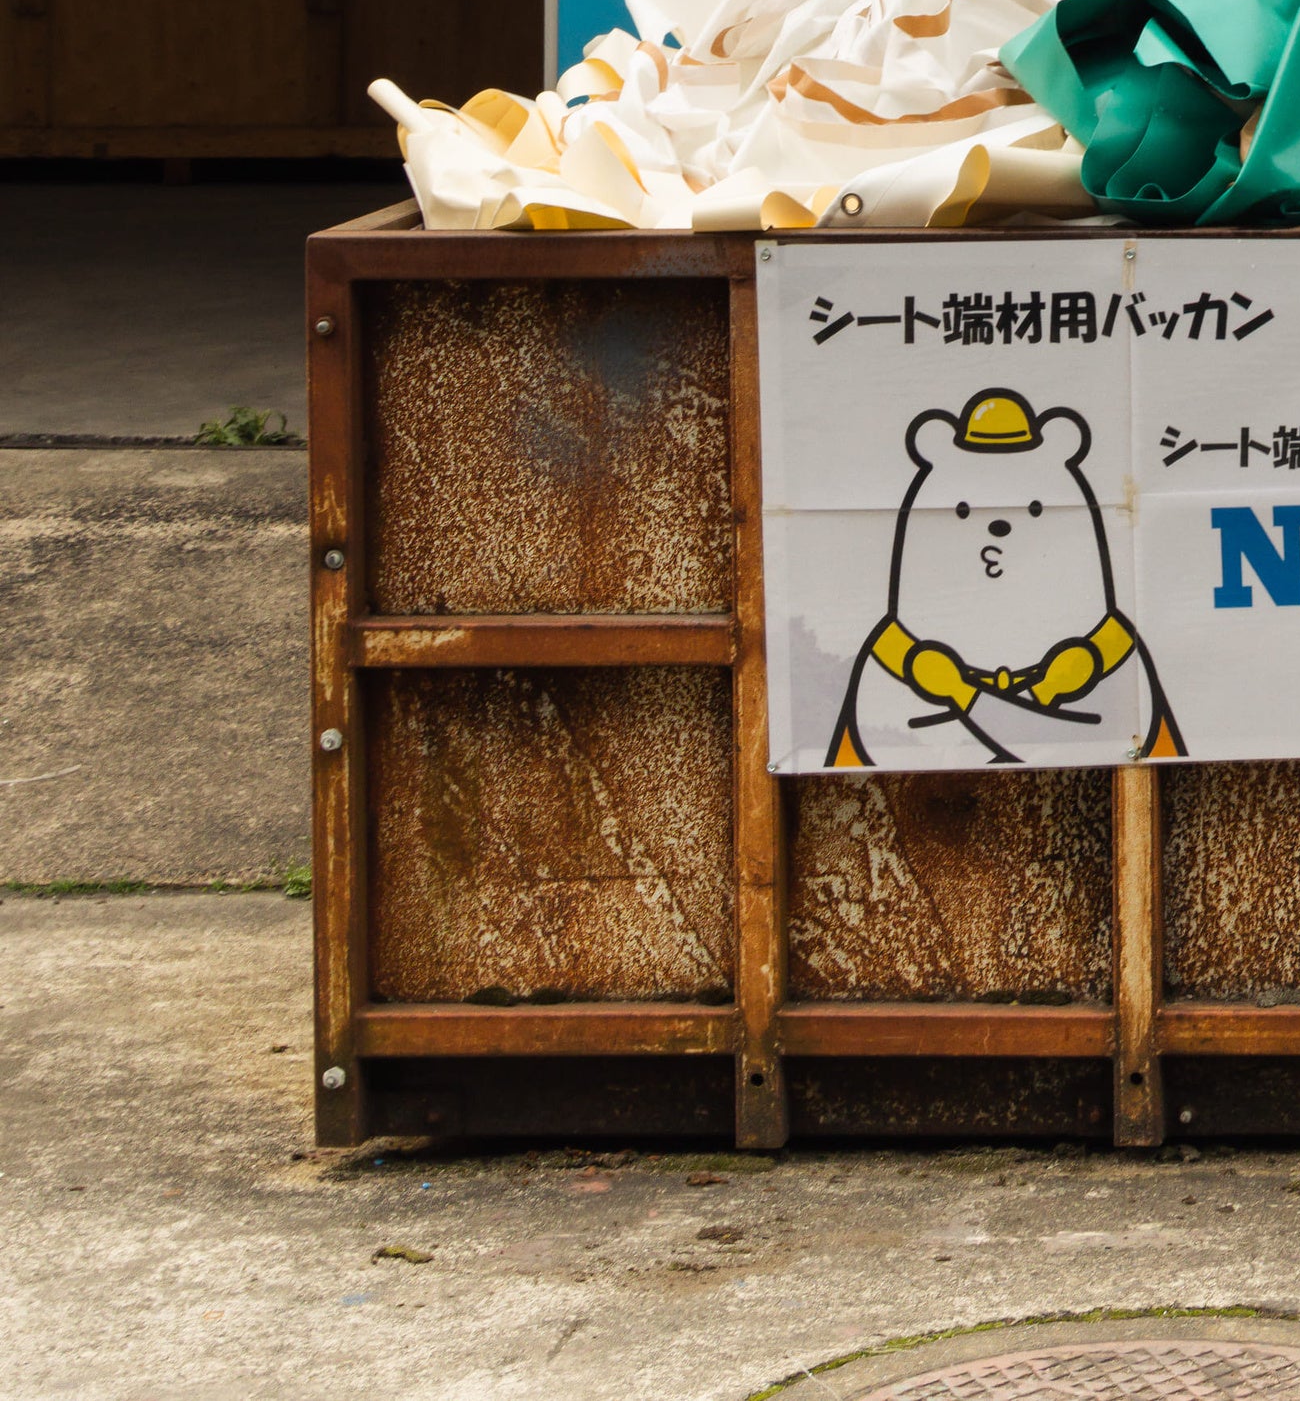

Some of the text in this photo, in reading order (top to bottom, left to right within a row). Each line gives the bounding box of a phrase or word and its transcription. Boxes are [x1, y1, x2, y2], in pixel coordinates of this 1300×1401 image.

[809, 291, 1275, 346] シート端材用バッカン
